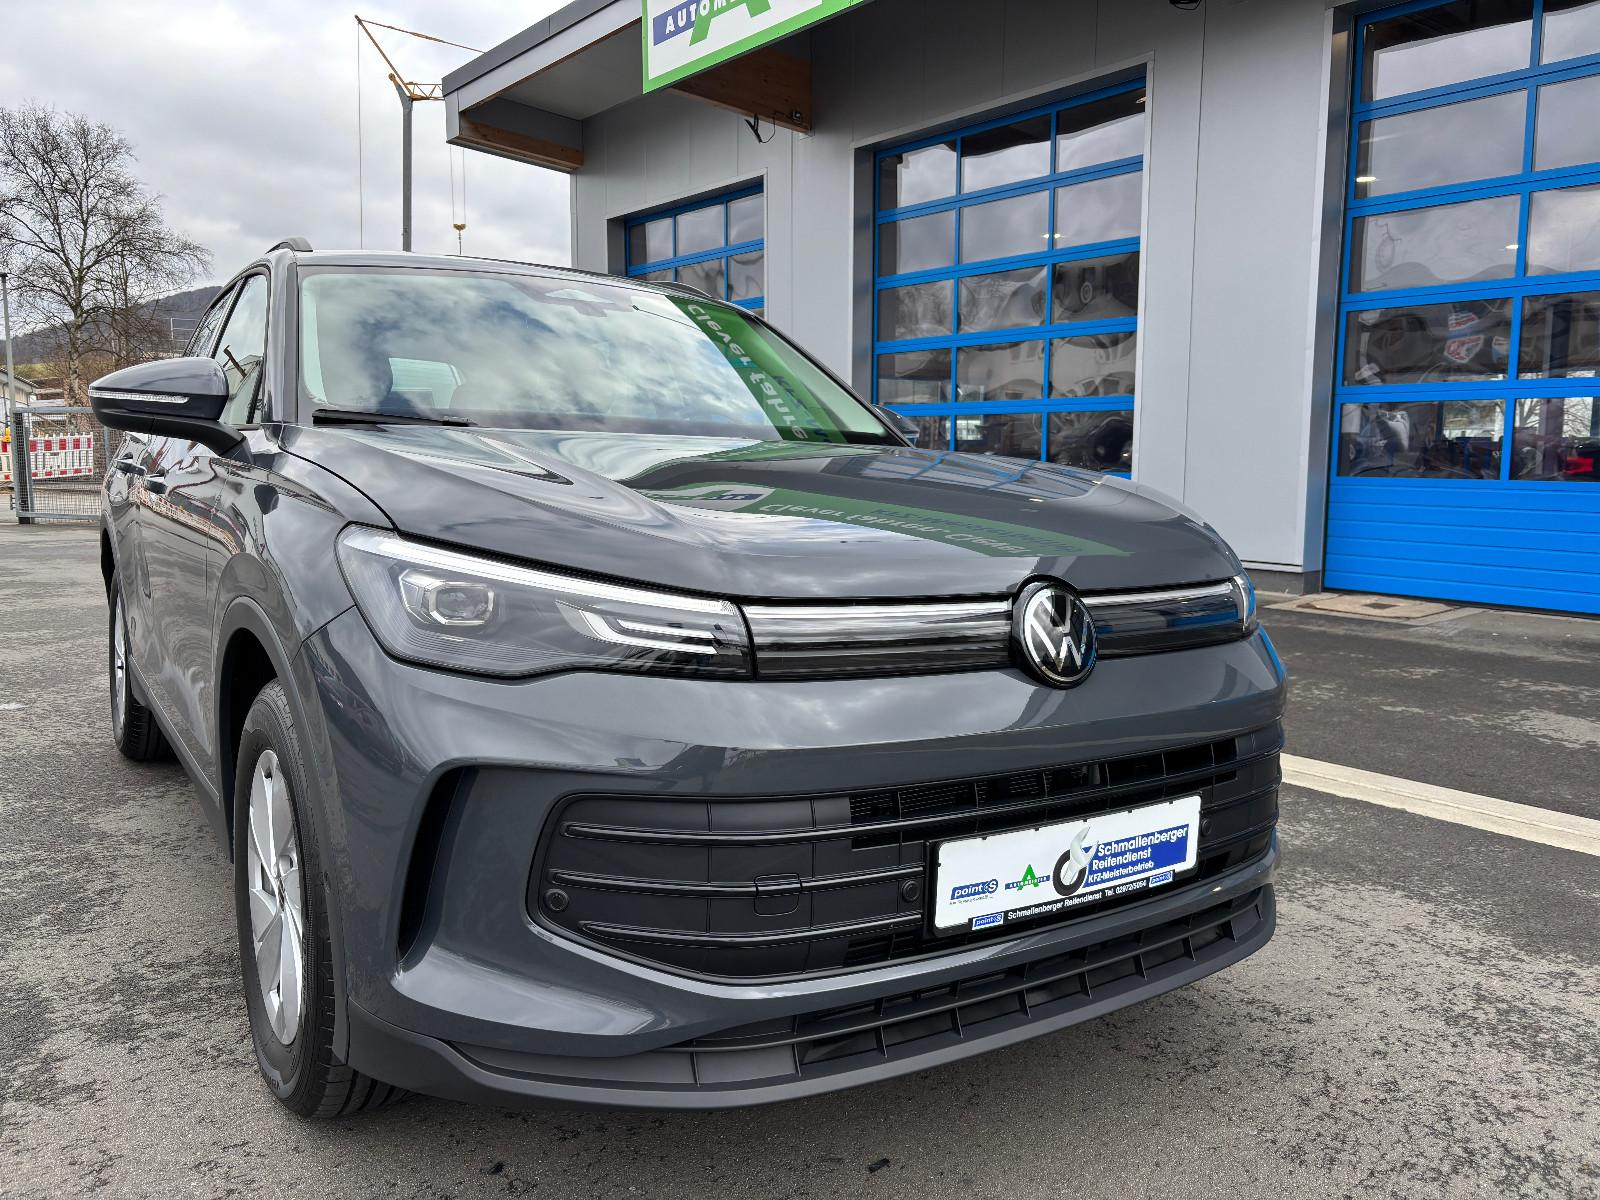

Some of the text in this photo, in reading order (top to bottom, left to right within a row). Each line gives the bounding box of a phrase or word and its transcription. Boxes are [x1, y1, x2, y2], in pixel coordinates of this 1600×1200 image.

[665, 0, 736, 34] AUTOM
[1097, 826, 1188, 857] Schmallenberger
[1088, 860, 1155, 883] KFZ-Meisterbetrieb
[1092, 847, 1152, 871] Reifendienst
[1007, 900, 1063, 920] Schmallenberger
[1064, 892, 1102, 907] Reifendienst
[1104, 887, 1115, 897] Tel.
